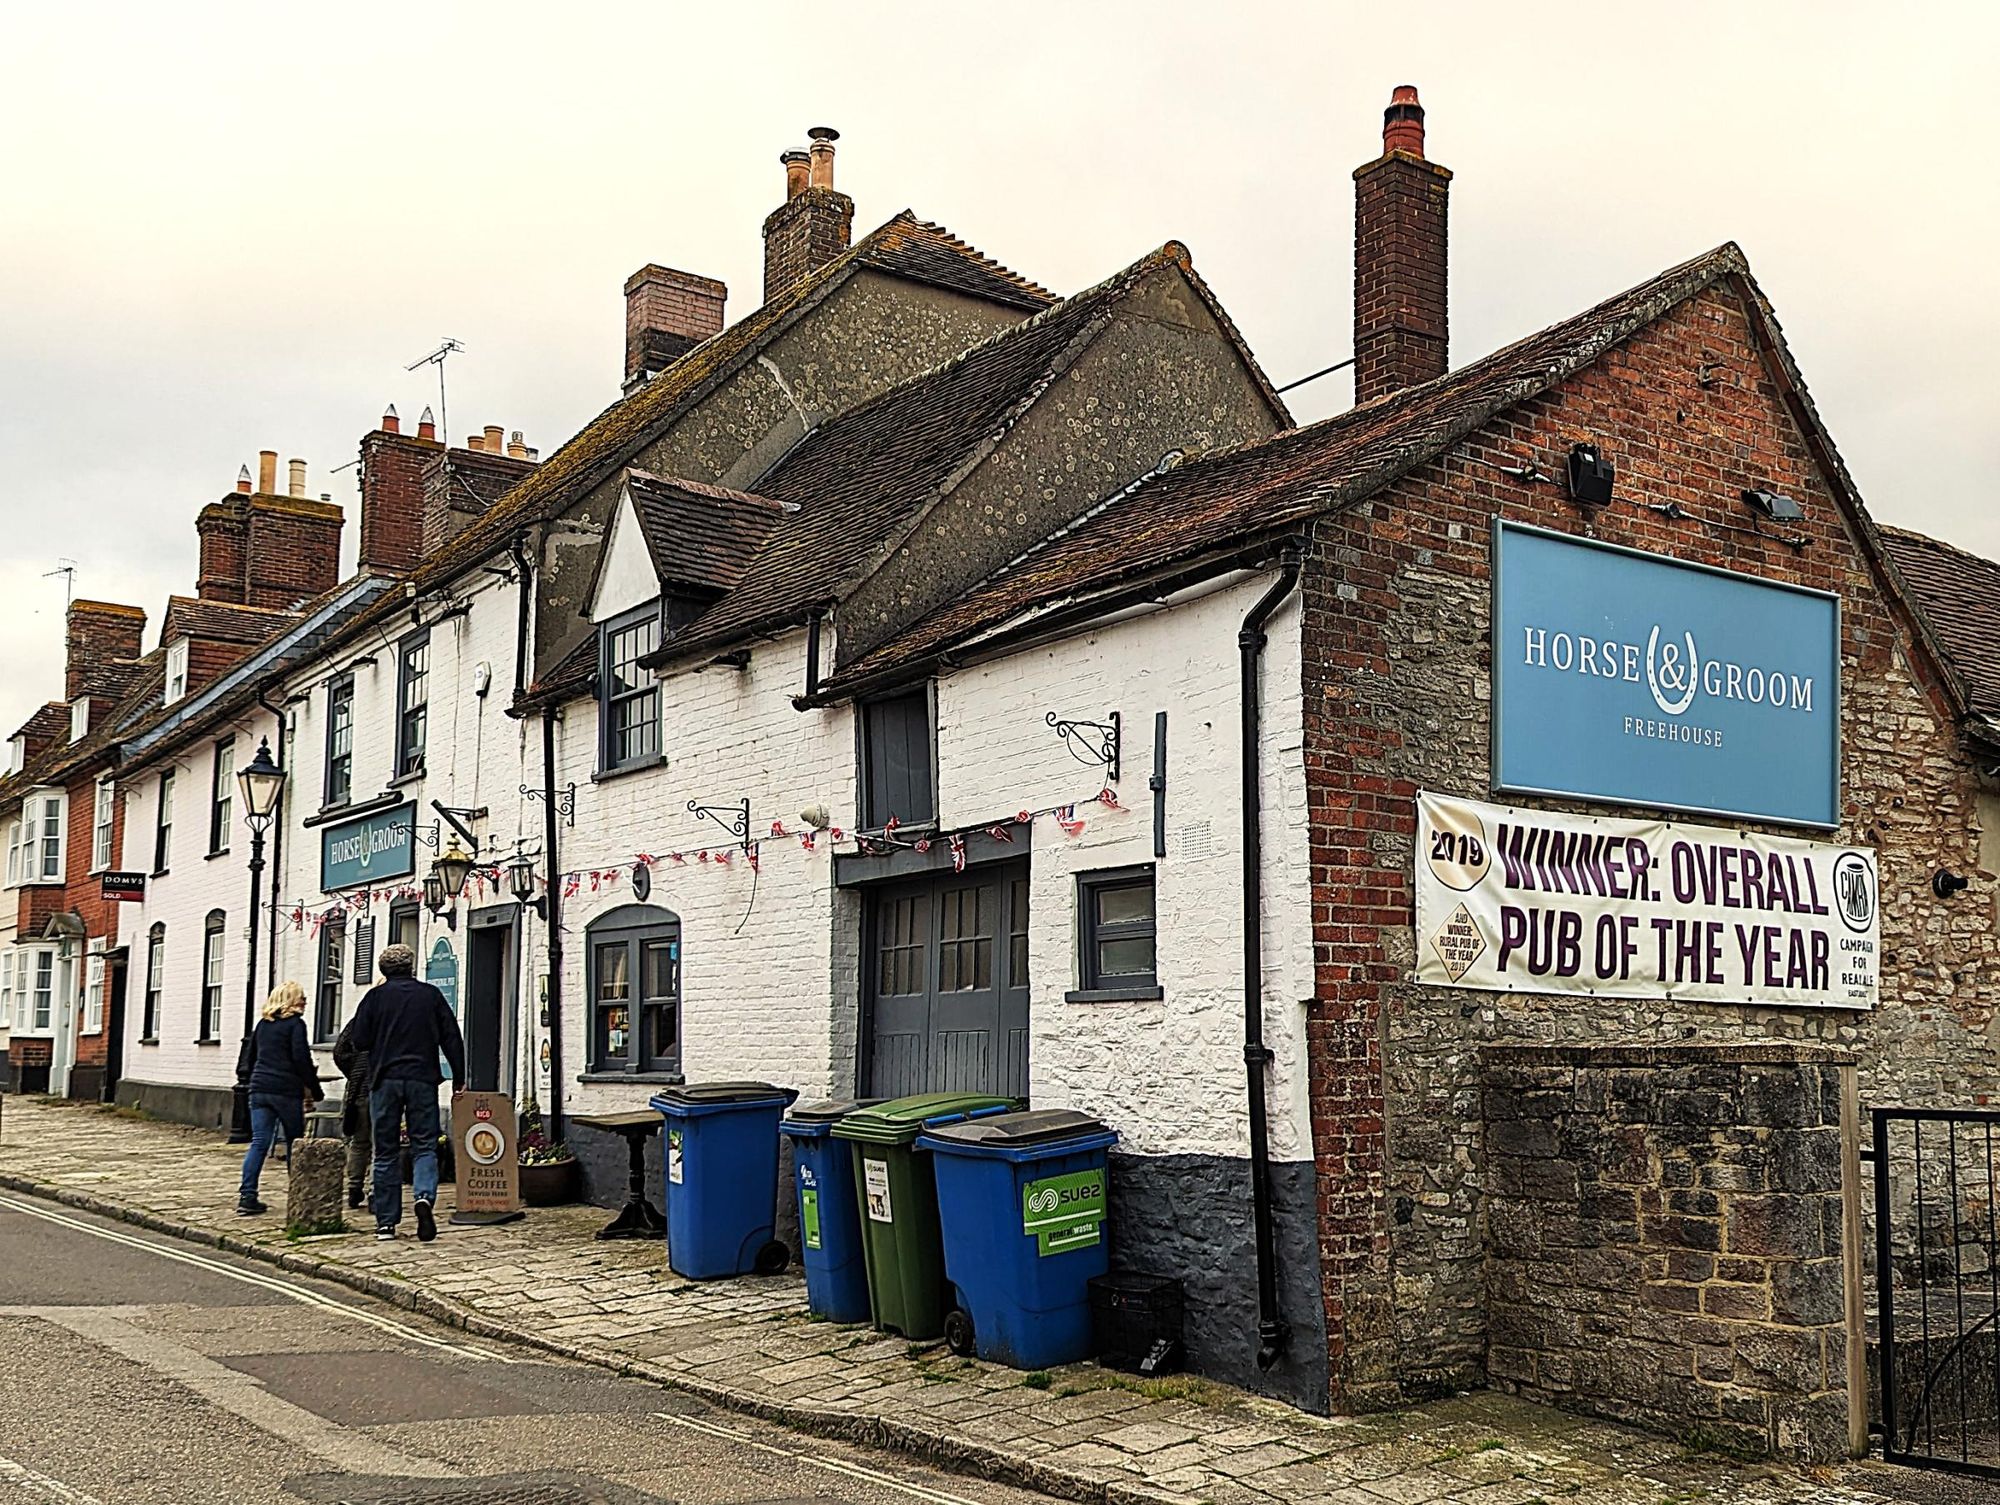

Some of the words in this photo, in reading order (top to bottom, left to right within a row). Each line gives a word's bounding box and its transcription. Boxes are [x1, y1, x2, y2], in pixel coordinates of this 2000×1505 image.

[1524, 626, 1641, 683] HORSE
[1658, 643, 1688, 692] &
[1703, 660, 1814, 712] GROOM
[1624, 716, 1723, 748] FREEHOUSE
[331, 836, 360, 865] HORSE
[1431, 830, 1484, 867] 2019
[1497, 823, 1661, 902] WINNER:
[1671, 840, 1830, 916] OVERALL
[105, 876, 144, 884] DOMVS
[1454, 912, 1468, 924] AND
[1439, 935, 1459, 948] RURAL
[1460, 937, 1472, 950] PUB
[1472, 938, 1481, 950] OF
[1497, 905, 1583, 978] PUB
[1594, 913, 1639, 981] OF
[1650, 918, 1725, 985] THE
[1734, 923, 1830, 991] YEAR
[1445, 948, 1457, 960] THE
[1458, 949, 1474, 962] YEAR
[470, 1167, 504, 1178] FRESH
[467, 1179, 508, 1189] COFFEE
[1048, 1227, 1074, 1241] general
[1073, 1223, 1093, 1235] waste
